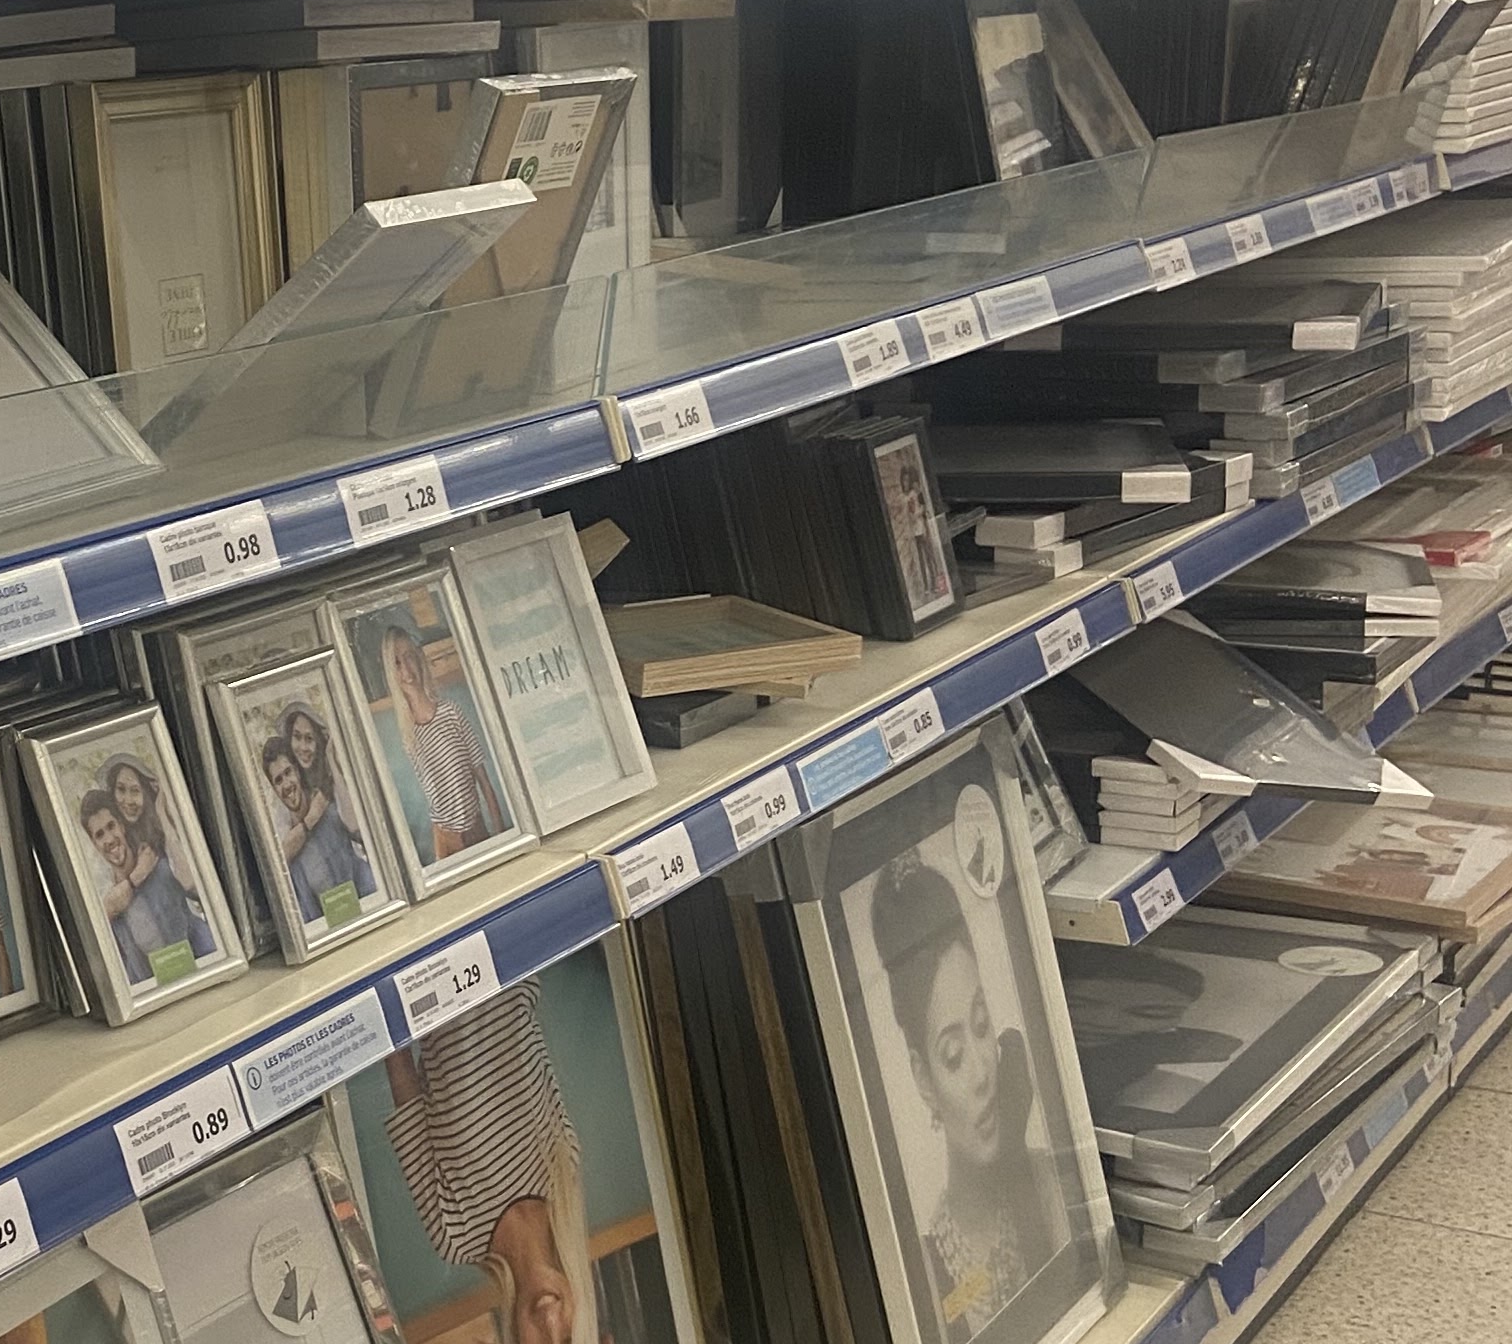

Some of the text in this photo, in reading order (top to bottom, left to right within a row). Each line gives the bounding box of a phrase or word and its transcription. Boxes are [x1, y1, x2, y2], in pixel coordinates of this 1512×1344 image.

[674, 406, 700, 429] 1.66
[405, 485, 436, 512] 1.28
[224, 534, 260, 563] 0.98
[500, 645, 570, 699] DREAM
[764, 794, 786, 818] 0.99
[660, 855, 684, 881] 1.49
[453, 964, 481, 994] 1.29
[263, 1012, 355, 1070] LES PHOTOS ET LES CADRES
[128, 1125, 145, 1138] Cadre
[146, 1116, 162, 1130] photo
[192, 1108, 228, 1144] 0.89
